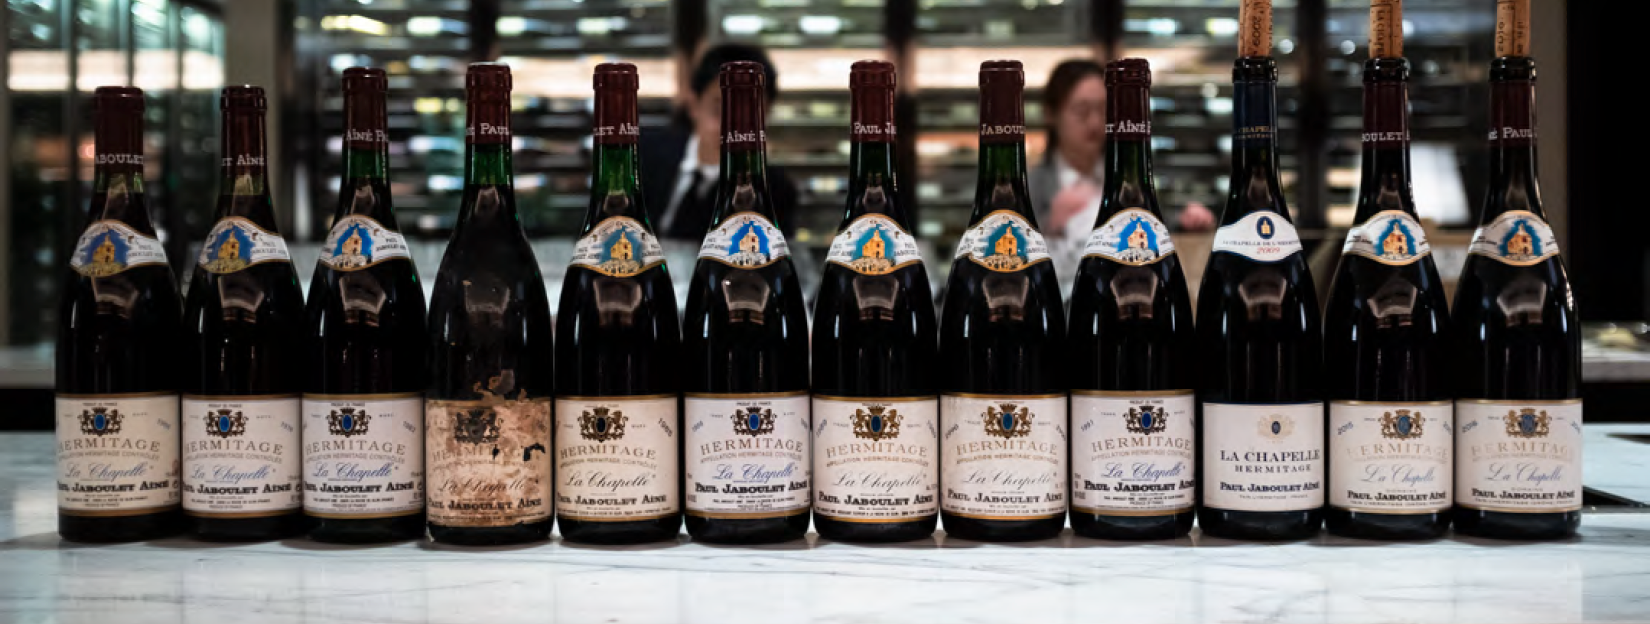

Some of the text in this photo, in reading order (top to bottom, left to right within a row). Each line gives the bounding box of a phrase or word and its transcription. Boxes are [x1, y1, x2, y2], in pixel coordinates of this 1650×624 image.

[854, 122, 882, 135] PAUL
[560, 444, 656, 460] HERMITAGE
[700, 437, 803, 455] HERMITAGE
[826, 442, 927, 458] HERMITAGE
[956, 440, 1057, 455] HERMITAGE
[1091, 436, 1191, 453] HERMITAGE
[1220, 449, 1320, 462] LA CHAPELLE
[88, 461, 148, 482] Chapelle
[212, 463, 270, 484] Chapelle
[313, 462, 394, 482] La Chapelle
[712, 462, 795, 484] La Chapelle
[1101, 461, 1183, 483] La Chapelle
[1235, 464, 1311, 474] HERMITAGE
[1361, 464, 1437, 487] La Chapelle
[1485, 462, 1563, 486] La Chapelle
[564, 468, 650, 492] La Chapelle
[832, 468, 922, 492] La Chapelle
[962, 469, 1051, 490] La Chapelle
[1084, 480, 1110, 491] PAUL
[1114, 482, 1176, 492] JABOULET
[1220, 481, 1246, 492] PAUL
[1247, 483, 1301, 492] JABOULET
[72, 482, 135, 493] JABOULET
[198, 484, 258, 494] JABOULET
[320, 483, 382, 493] JABOULET
[695, 482, 718, 493] PAUL
[723, 484, 785, 494] JABOULET
[1472, 488, 1497, 498] PAUL
[1499, 490, 1555, 500] JABOULET
[574, 495, 637, 505] JABOULET
[819, 491, 840, 504] PAUL
[844, 495, 910, 506] JABOULET
[948, 489, 970, 502] PAUL
[975, 492, 1041, 503] JABOULET
[1347, 490, 1373, 500] PAUL
[1374, 492, 1428, 502] JABOULET
[448, 500, 513, 510] JABOULET
